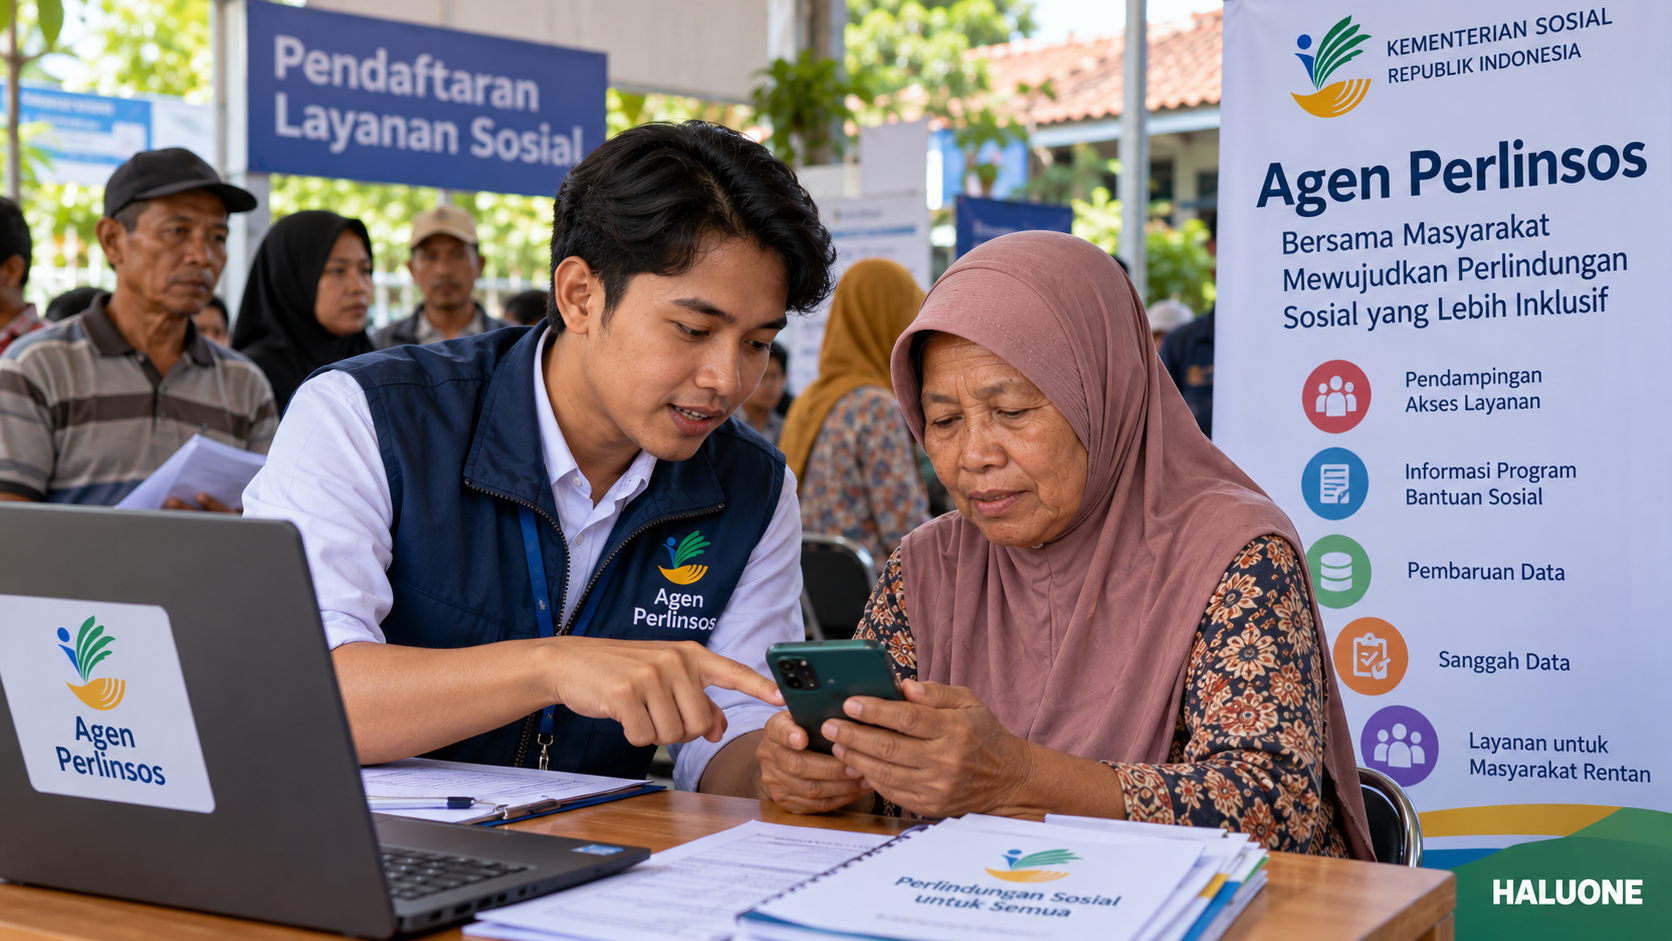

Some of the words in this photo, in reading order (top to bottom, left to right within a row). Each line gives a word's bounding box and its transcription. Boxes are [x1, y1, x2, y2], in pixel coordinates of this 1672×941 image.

[1387, 21, 1527, 57] KEMENTERIAN
[1536, 7, 1612, 35] SOSIAL
[275, 34, 539, 112] Pendaftaran
[1388, 58, 1473, 83] REPUBLIK
[1479, 42, 1581, 71] INDONESIA
[275, 92, 459, 154] Layanan
[470, 116, 583, 166] Sosial
[1256, 162, 1390, 217] Agen
[1410, 139, 1647, 196] Perlinsos
[1282, 230, 1393, 255] Bersama
[1403, 214, 1550, 249] Masyarakat
[1283, 260, 1447, 294] Mewujudkan
[1458, 250, 1628, 281] Perlindungan
[1283, 301, 1358, 330] Sosial
[1367, 303, 1429, 332] yang
[1438, 293, 1506, 320] Lebih
[1516, 286, 1609, 316] Inklusif
[1405, 367, 1542, 390] Pendampingan
[1405, 395, 1459, 412] Akses
[1464, 394, 1541, 415] Layanan
[1405, 462, 1490, 480] Informasi
[1497, 462, 1576, 483] Program
[1405, 488, 1482, 505] Bantuan
[1489, 487, 1542, 505] Sosial
[1408, 561, 1514, 580] Pembaruan
[1521, 563, 1565, 581] Data
[654, 588, 704, 610] Agen
[633, 607, 716, 630] Perlinsos
[1439, 651, 1520, 674] Sanggah
[1526, 653, 1571, 671] Data
[75, 716, 136, 750] Agen
[1470, 732, 1547, 755] Layanan
[1553, 735, 1608, 753] untuk
[55, 746, 166, 786] Perlinsos
[1470, 759, 1577, 781] Masyarakat
[1584, 763, 1651, 783] Rentan
[894, 876, 1044, 900] Perlindungan
[1049, 892, 1121, 906] Sosial
[915, 895, 983, 910] untuk
[989, 901, 1071, 918] Semua
